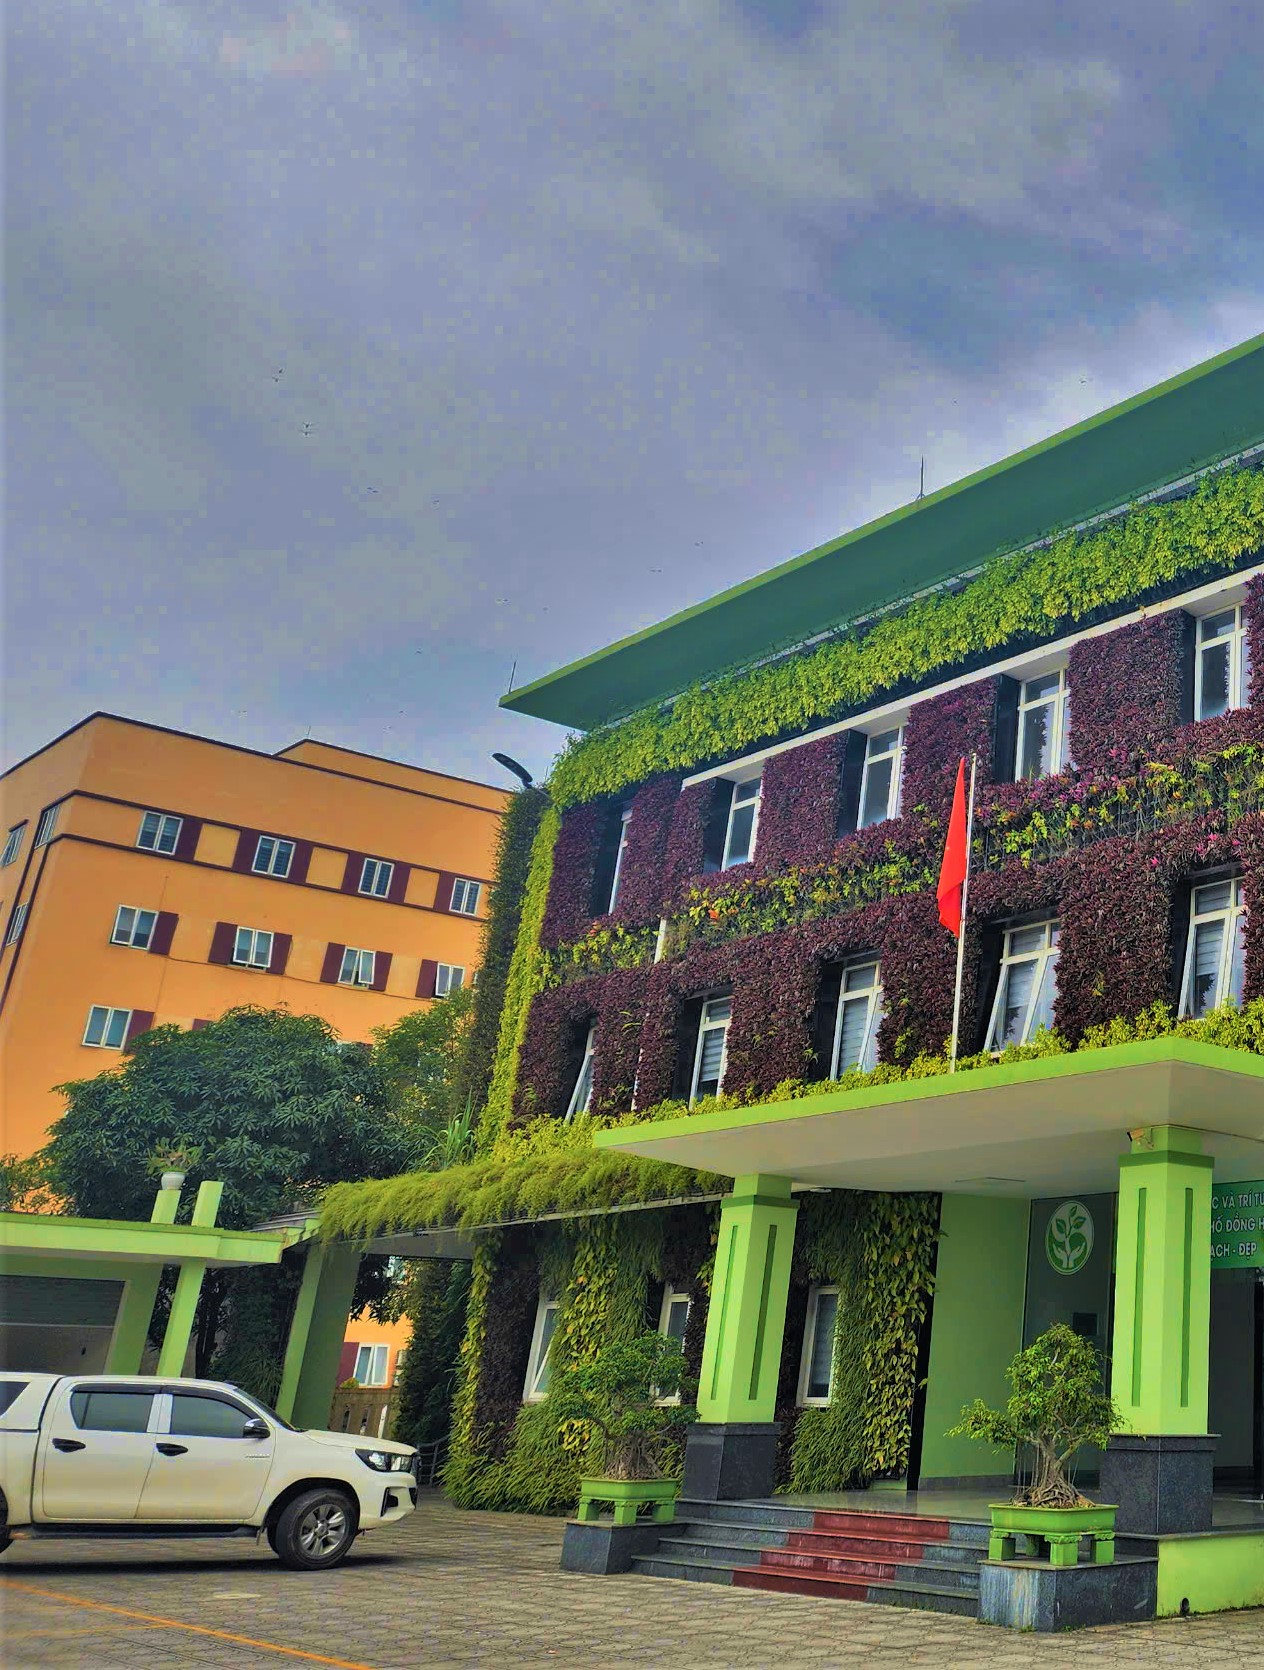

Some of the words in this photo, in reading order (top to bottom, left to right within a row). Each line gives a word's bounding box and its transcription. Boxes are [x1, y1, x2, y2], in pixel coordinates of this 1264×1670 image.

[1222, 1190, 1235, 1208] VÀ
[1238, 1190, 1252, 1207] TRÍ
[1226, 1213, 1256, 1232] ĐỒNG
[1210, 1243, 1230, 1261] ẠCH
[1239, 1242, 1257, 1260] ĐẸP
